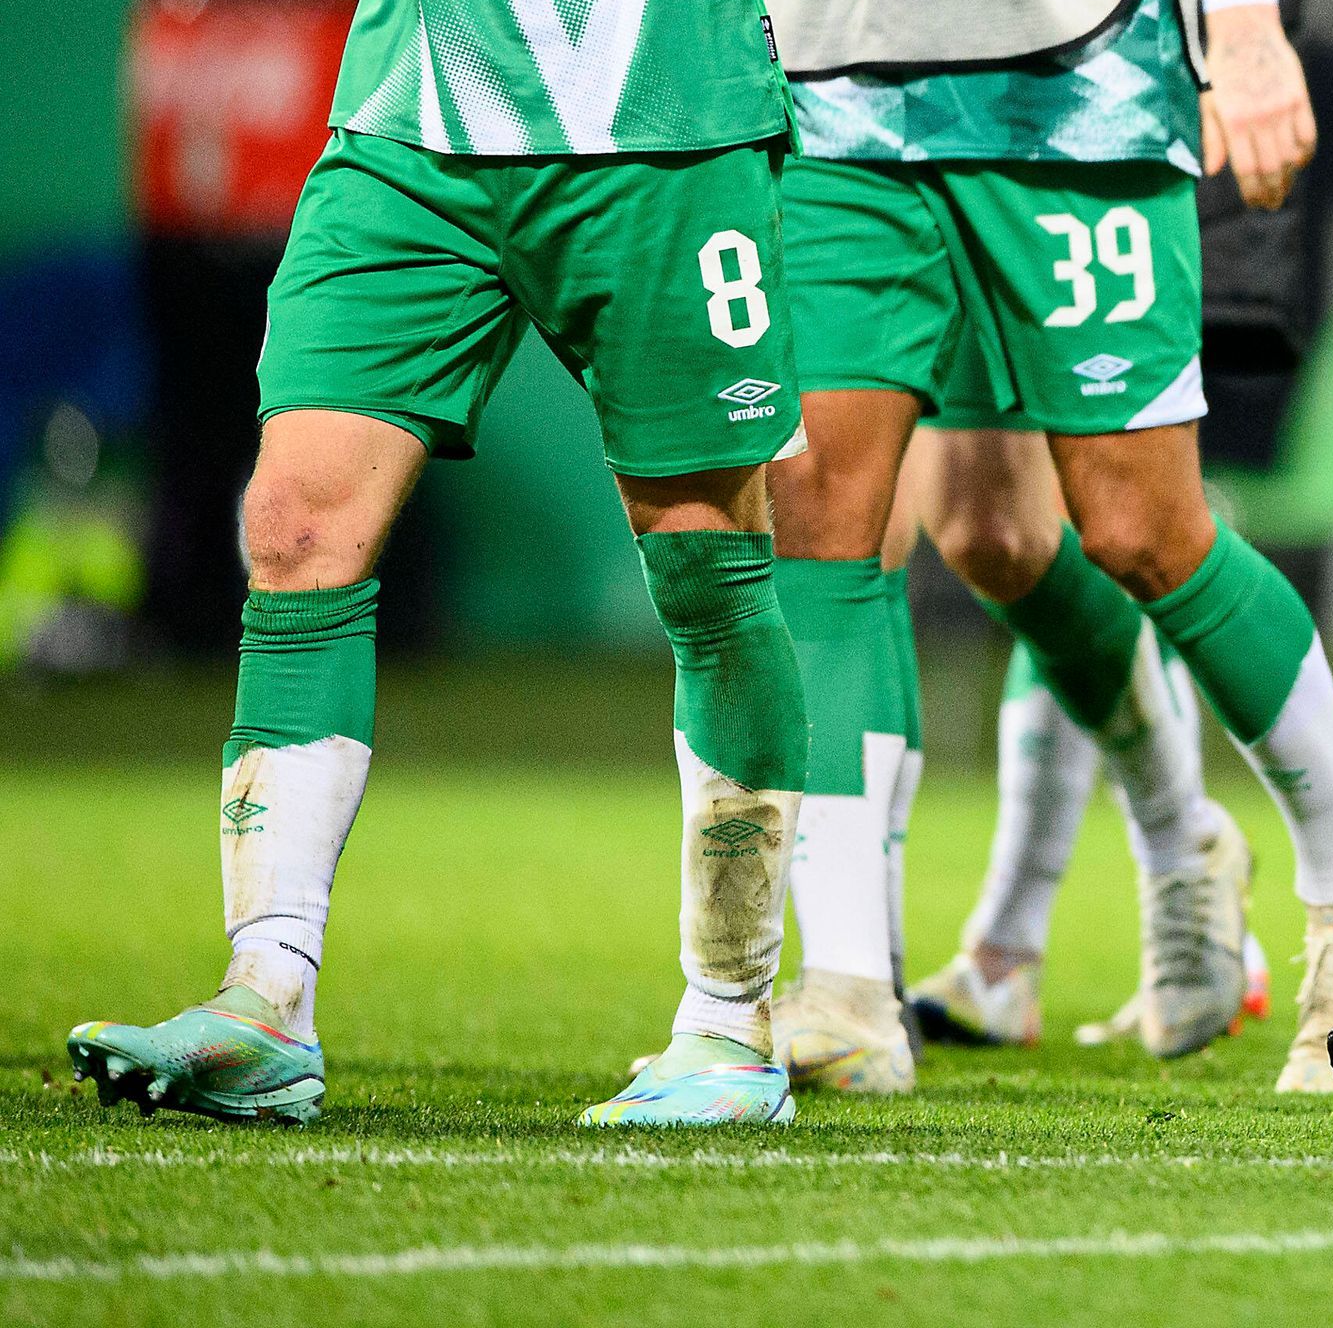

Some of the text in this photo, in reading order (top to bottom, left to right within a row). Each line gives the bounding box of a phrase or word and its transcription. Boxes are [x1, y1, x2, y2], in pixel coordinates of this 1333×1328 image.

[697, 228, 772, 349] 8
[1035, 205, 1157, 328] 39
[727, 404, 776, 422] umbro
